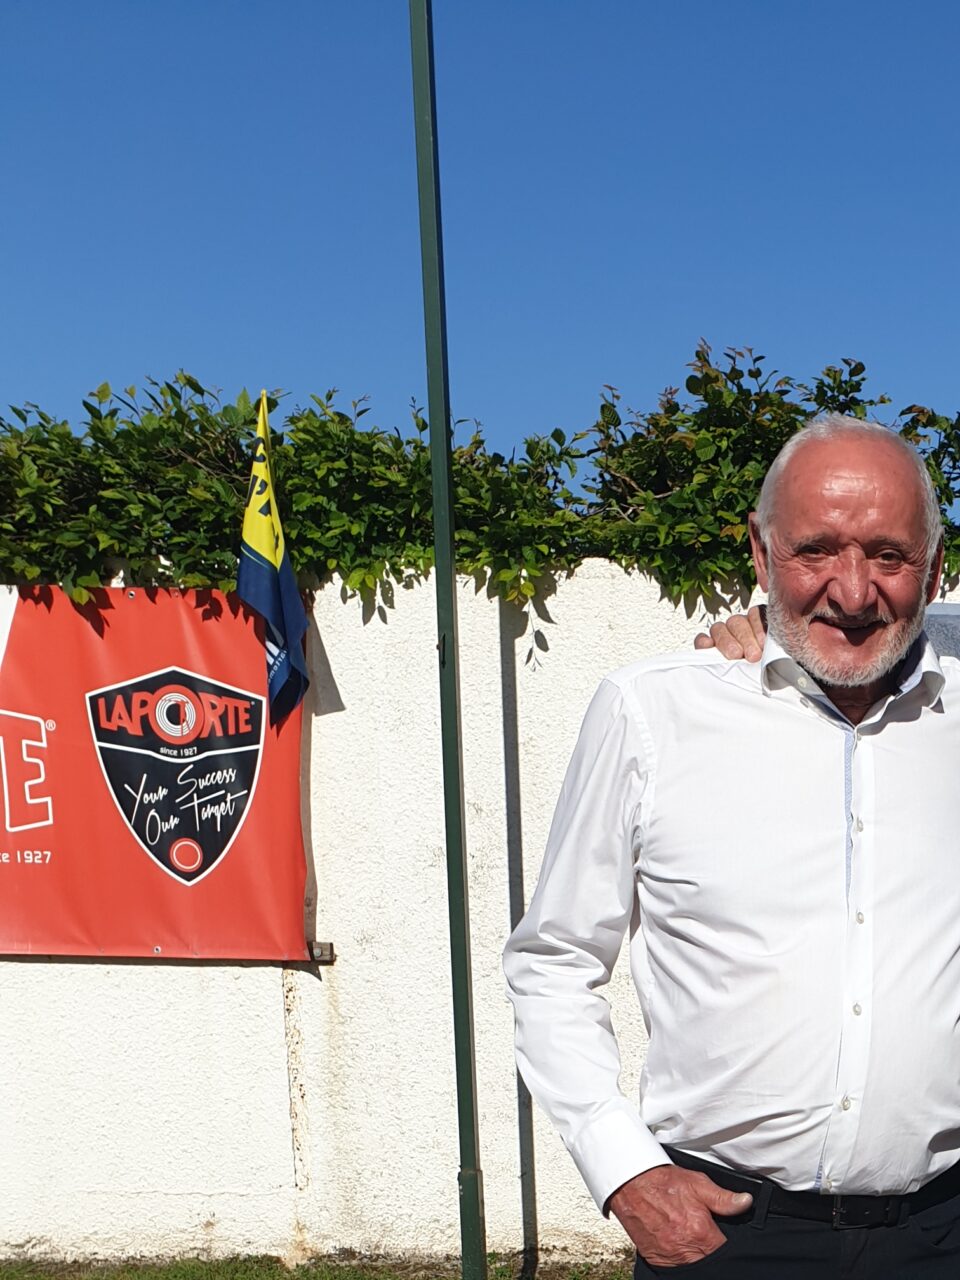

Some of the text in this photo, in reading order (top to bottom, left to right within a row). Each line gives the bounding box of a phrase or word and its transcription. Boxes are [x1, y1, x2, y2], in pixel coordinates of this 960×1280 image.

[97, 684, 253, 745] LAPORTE
[159, 746, 198, 757] since 1927
[124, 764, 237, 827] Your Success
[146, 789, 248, 846] Our Target
[16, 850, 52, 864] 1927
